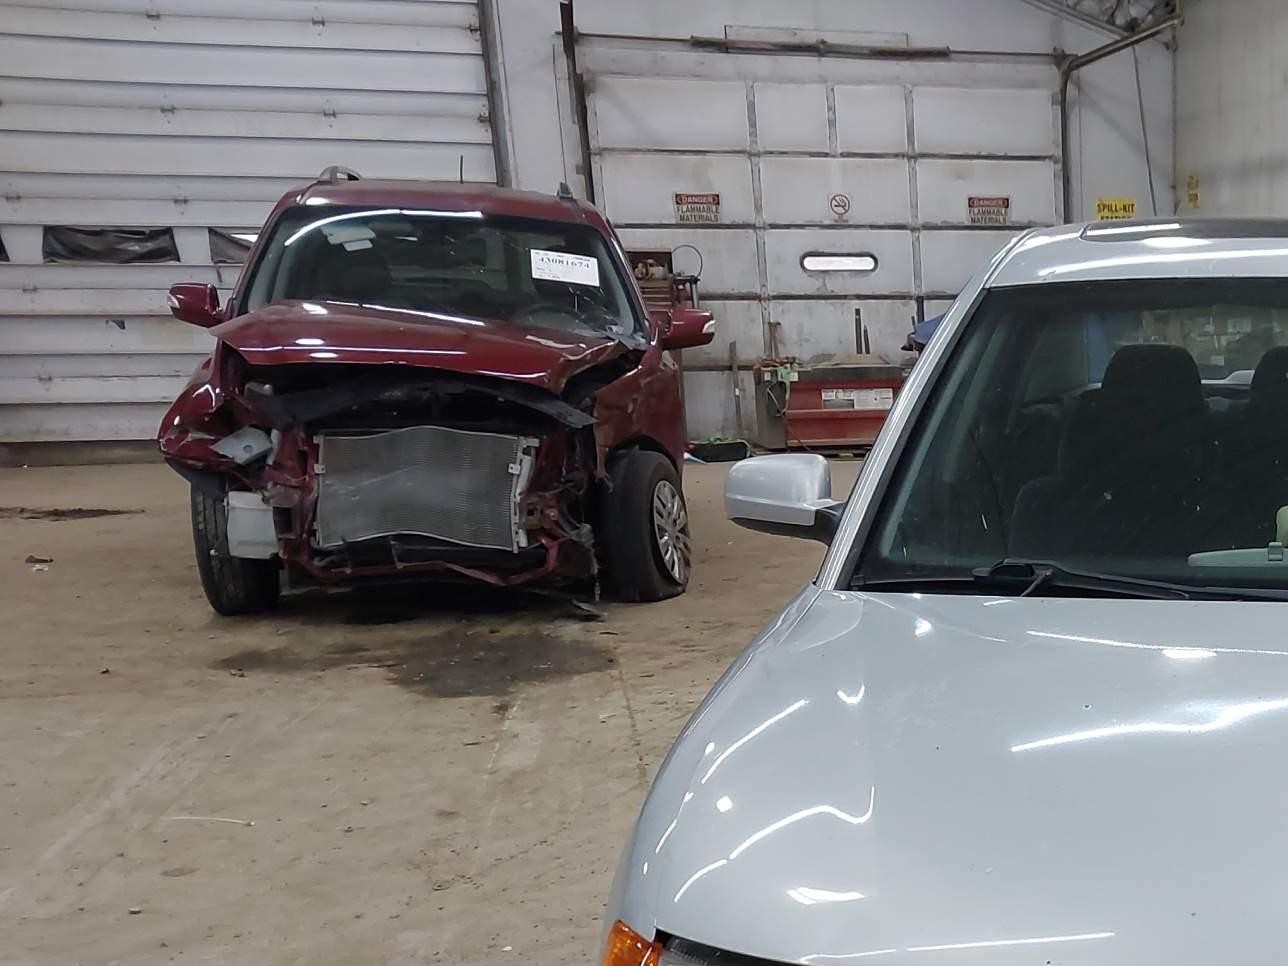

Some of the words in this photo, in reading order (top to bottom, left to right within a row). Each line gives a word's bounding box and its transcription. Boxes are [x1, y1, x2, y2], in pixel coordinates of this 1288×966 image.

[676, 205, 720, 214] FLAMMABLE
[968, 208, 1009, 216] FLAMMABLE
[1096, 203, 1135, 213] SPILL-KIT
[679, 214, 719, 222] MATERIALS
[970, 216, 1007, 225] MATERIALS
